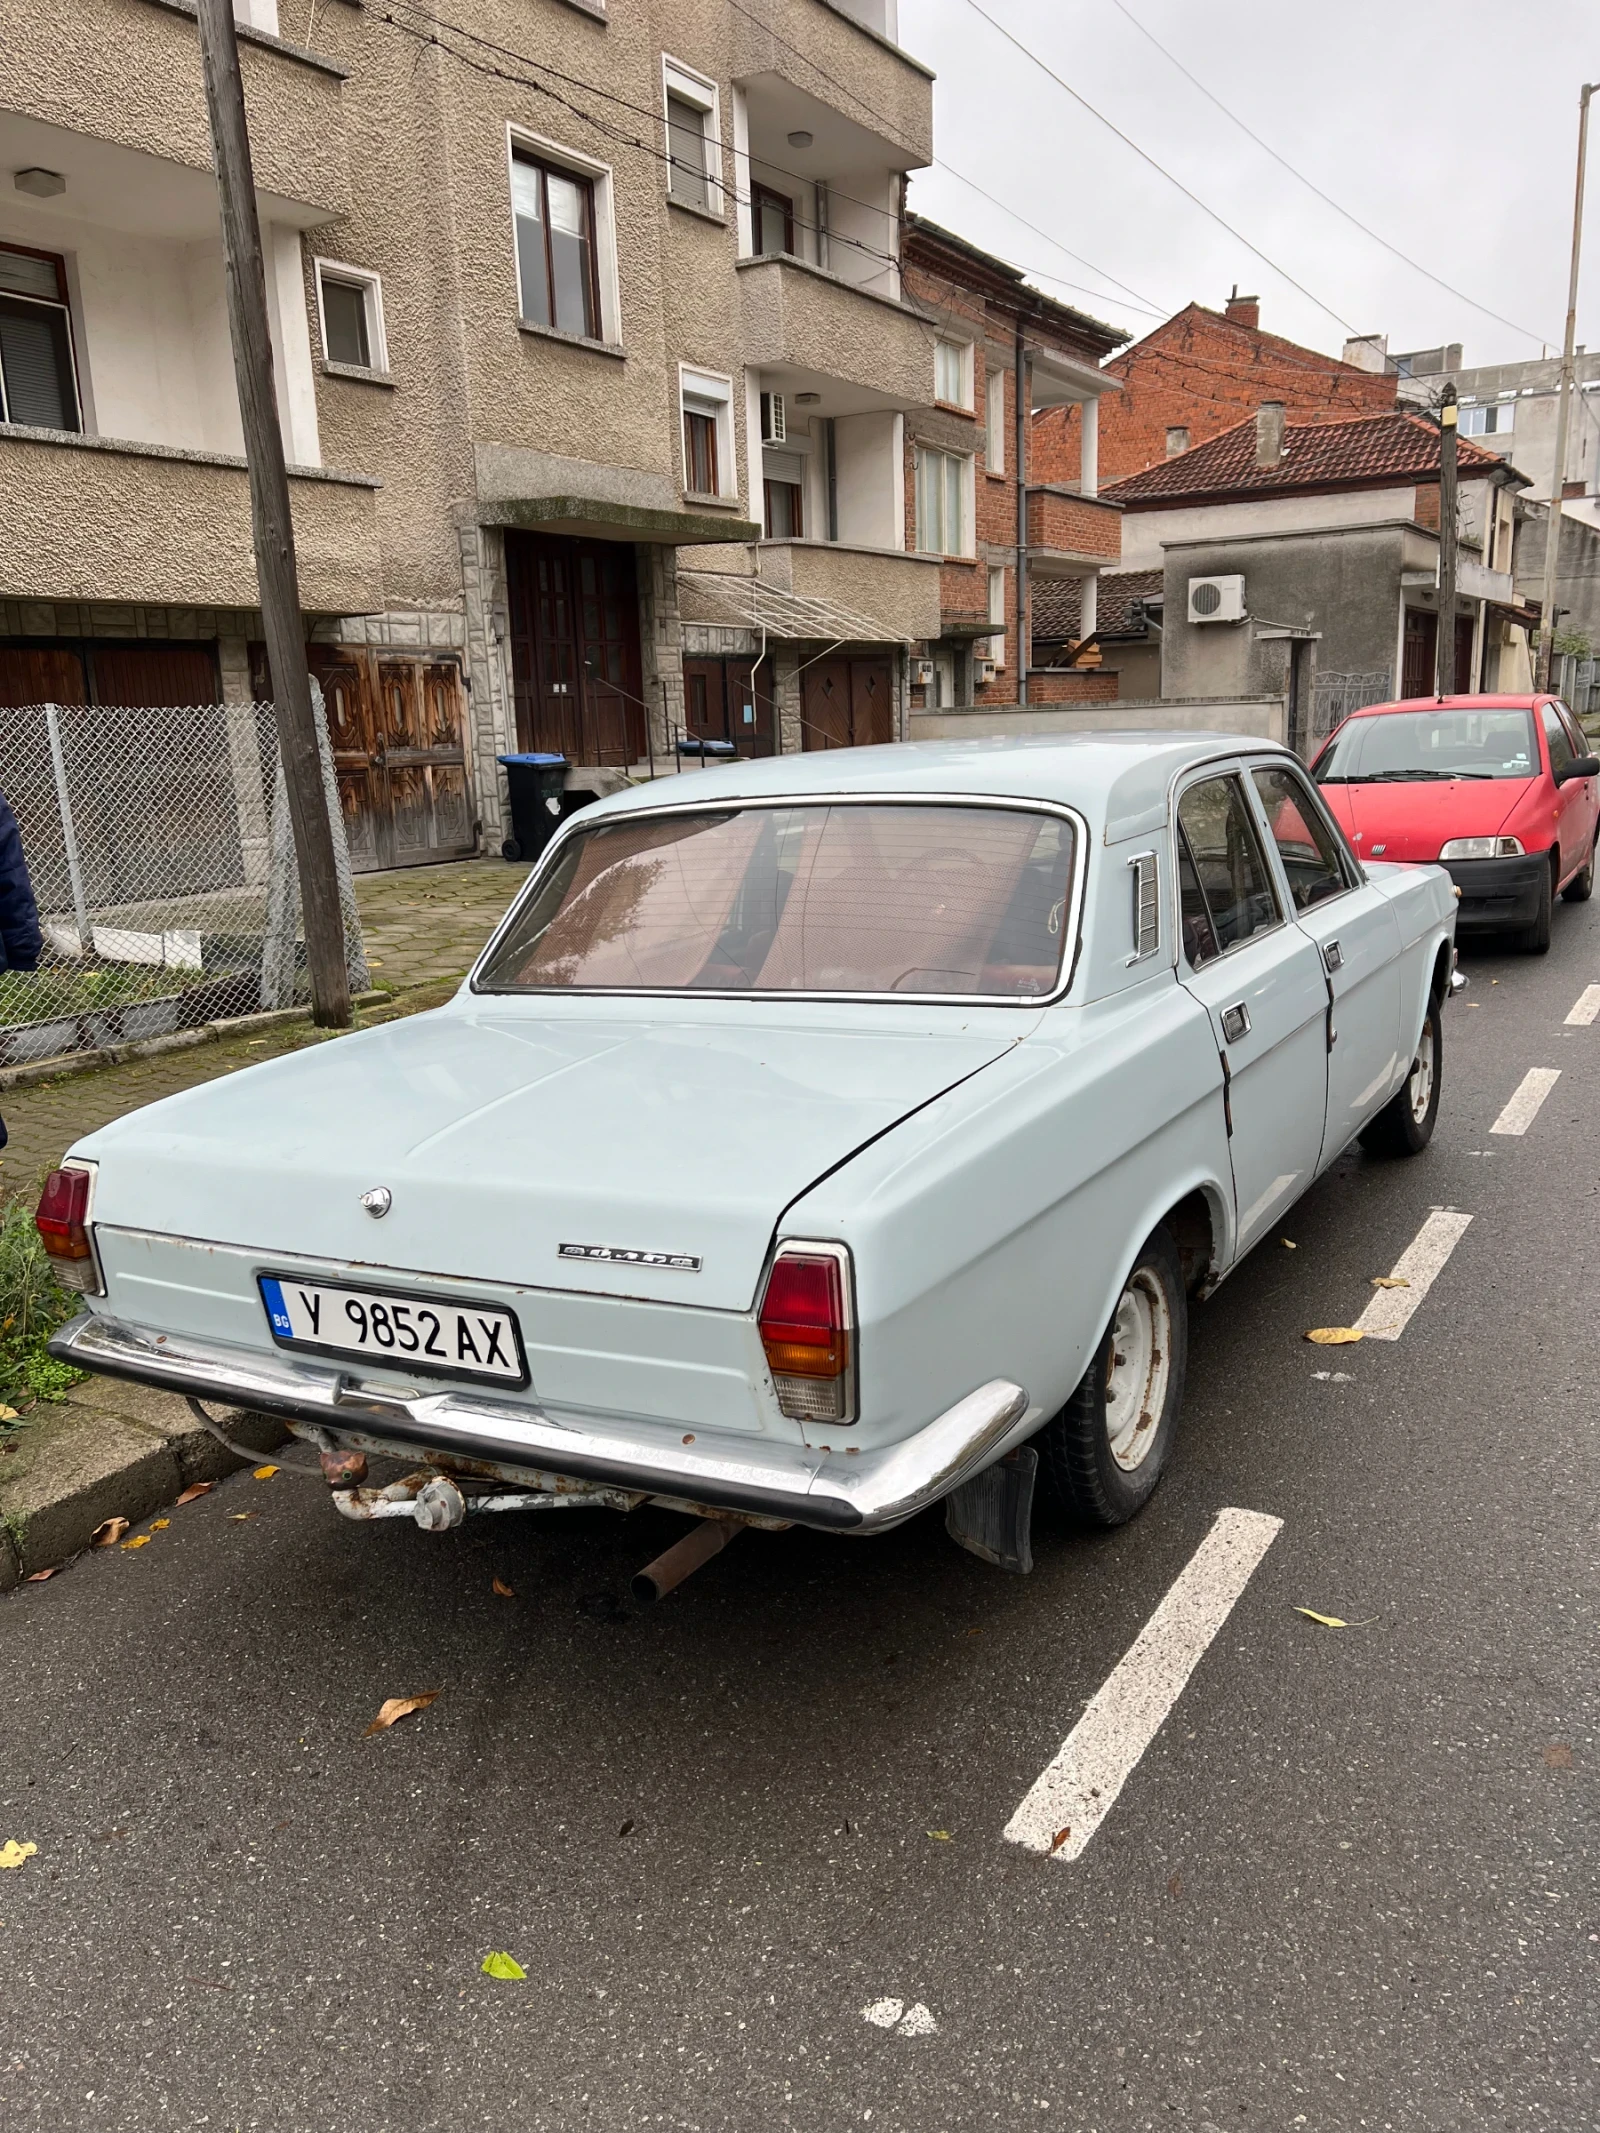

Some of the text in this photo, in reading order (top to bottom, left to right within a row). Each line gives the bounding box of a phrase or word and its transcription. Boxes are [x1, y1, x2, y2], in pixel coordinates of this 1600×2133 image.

[273, 1313, 290, 1329] BG
[299, 1291, 511, 1368] Y 9852 AX
